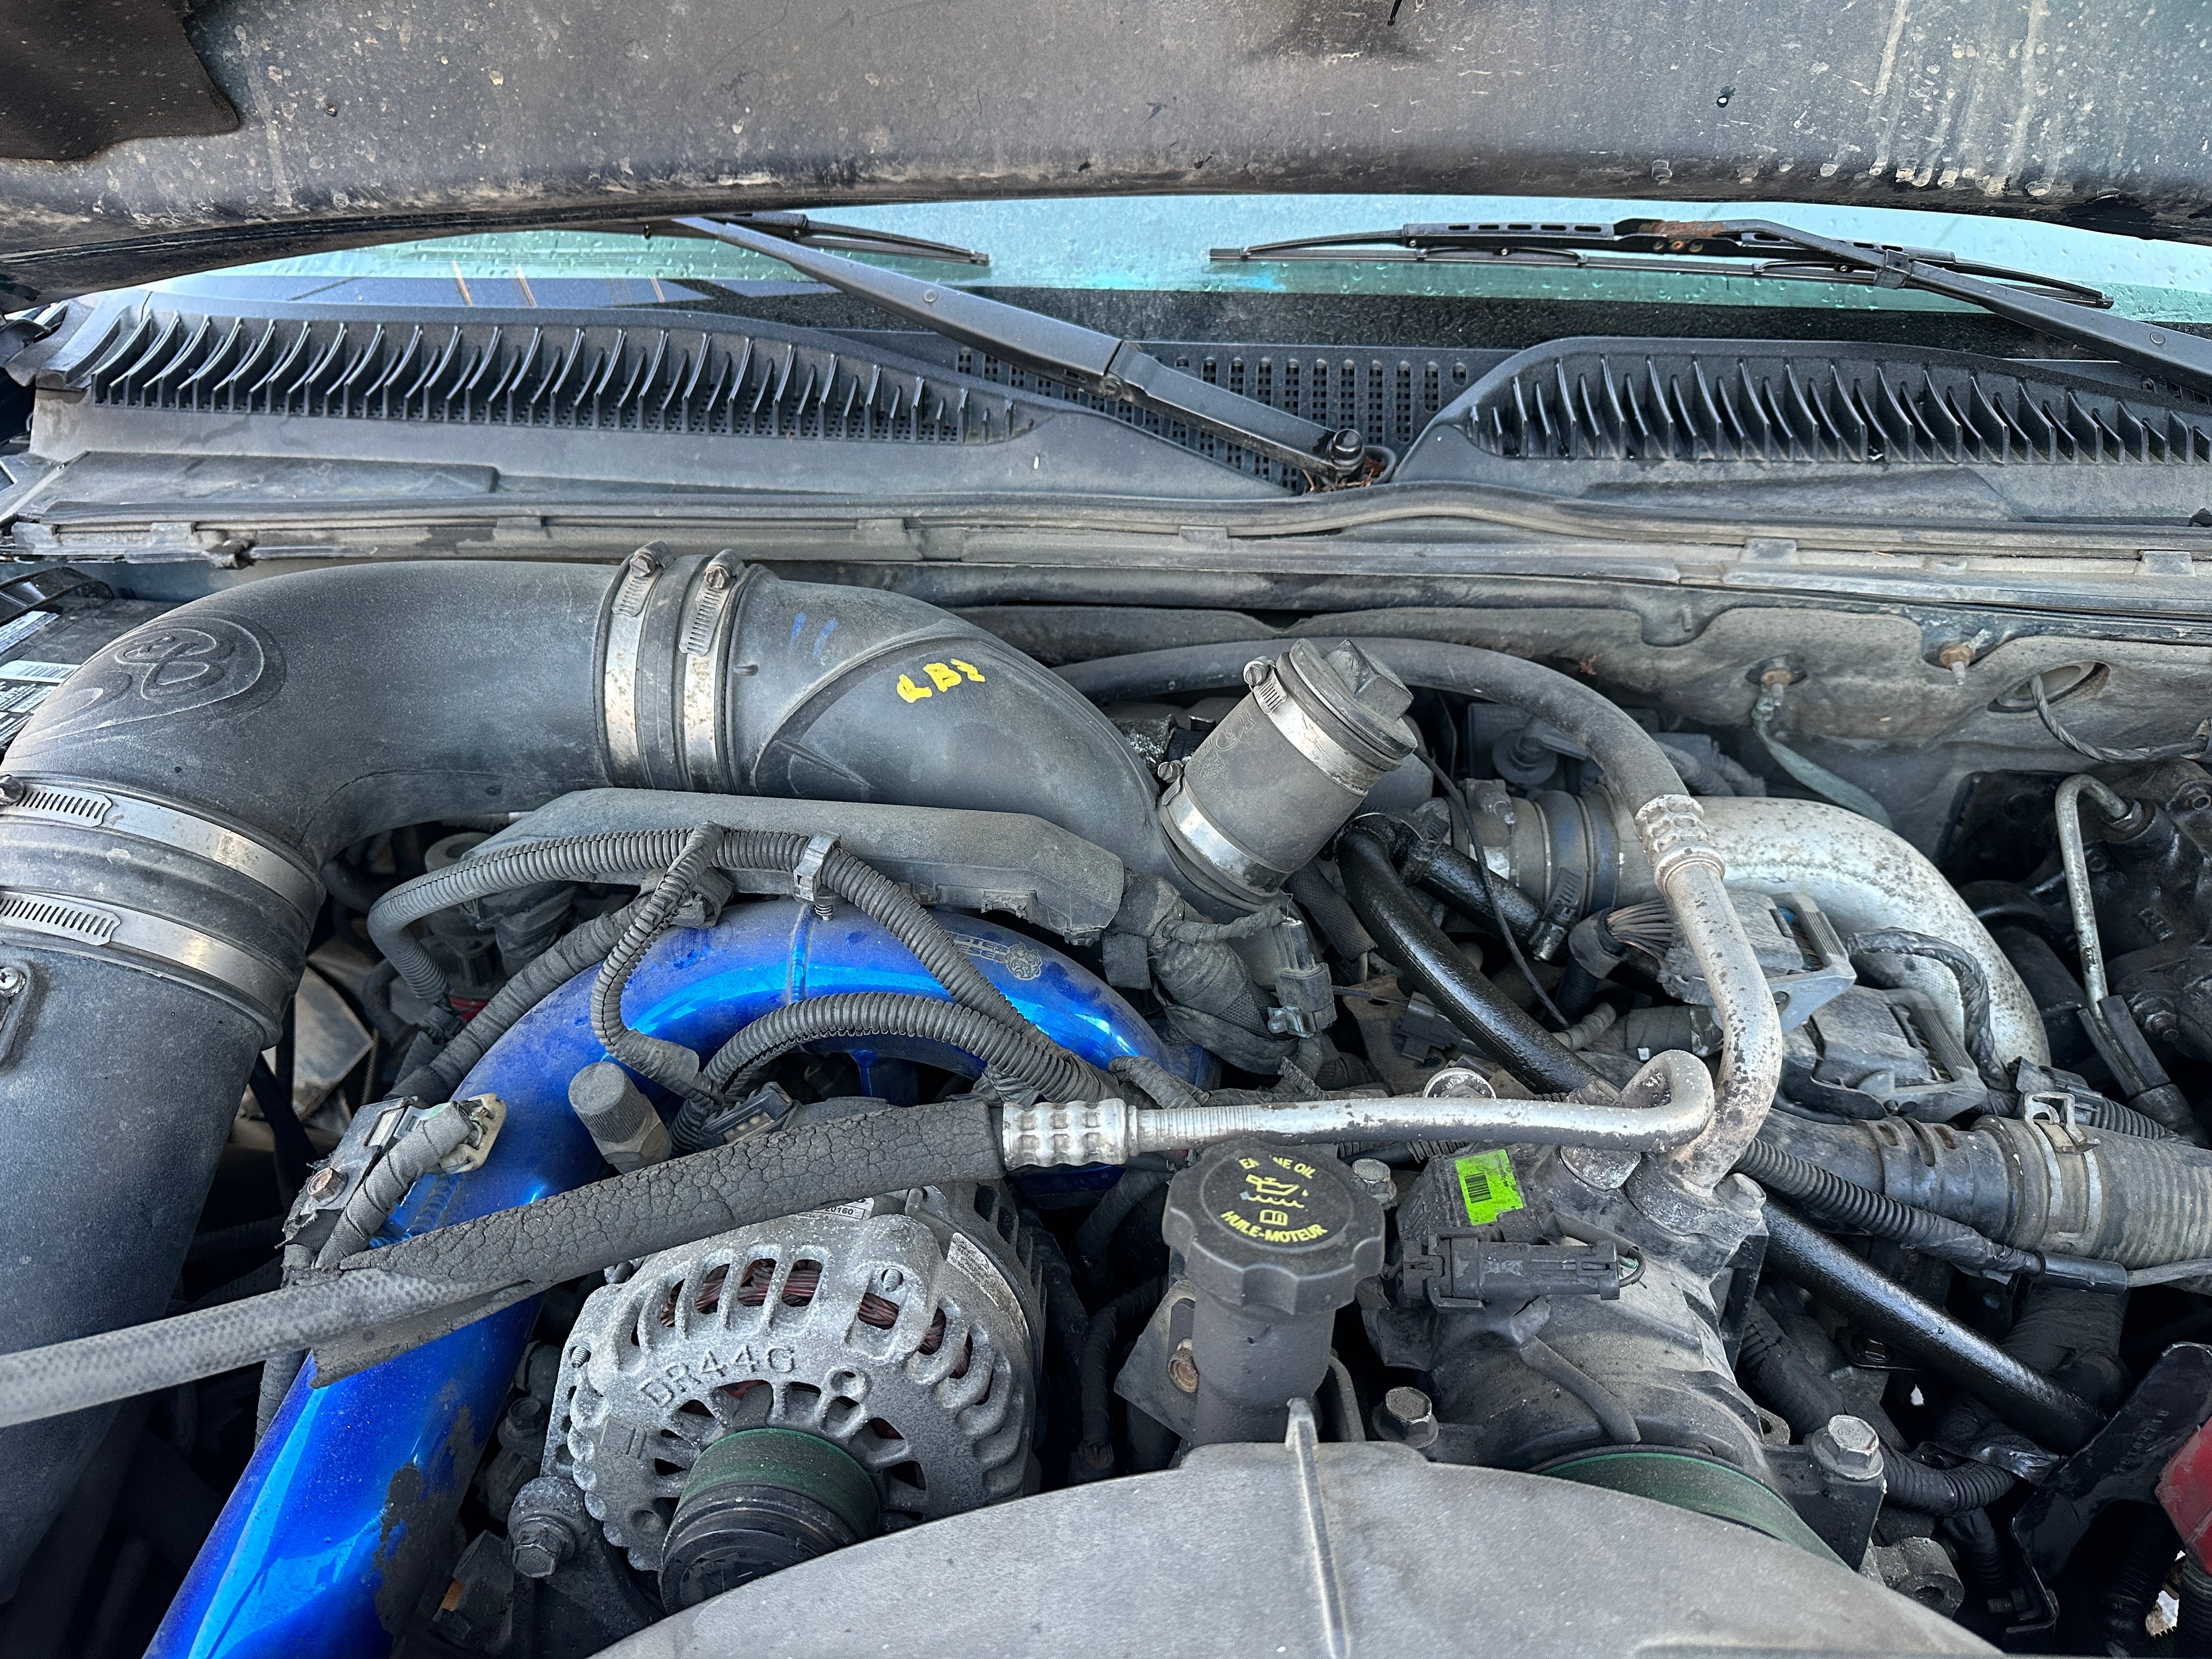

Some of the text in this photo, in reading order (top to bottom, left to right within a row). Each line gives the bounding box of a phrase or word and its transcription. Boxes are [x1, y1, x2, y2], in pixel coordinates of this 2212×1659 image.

[1294, 1163, 1316, 1179] OIL
[1219, 1210, 1328, 1243] HUILE-MOTEUR
[637, 1344, 796, 1408] DR44G
